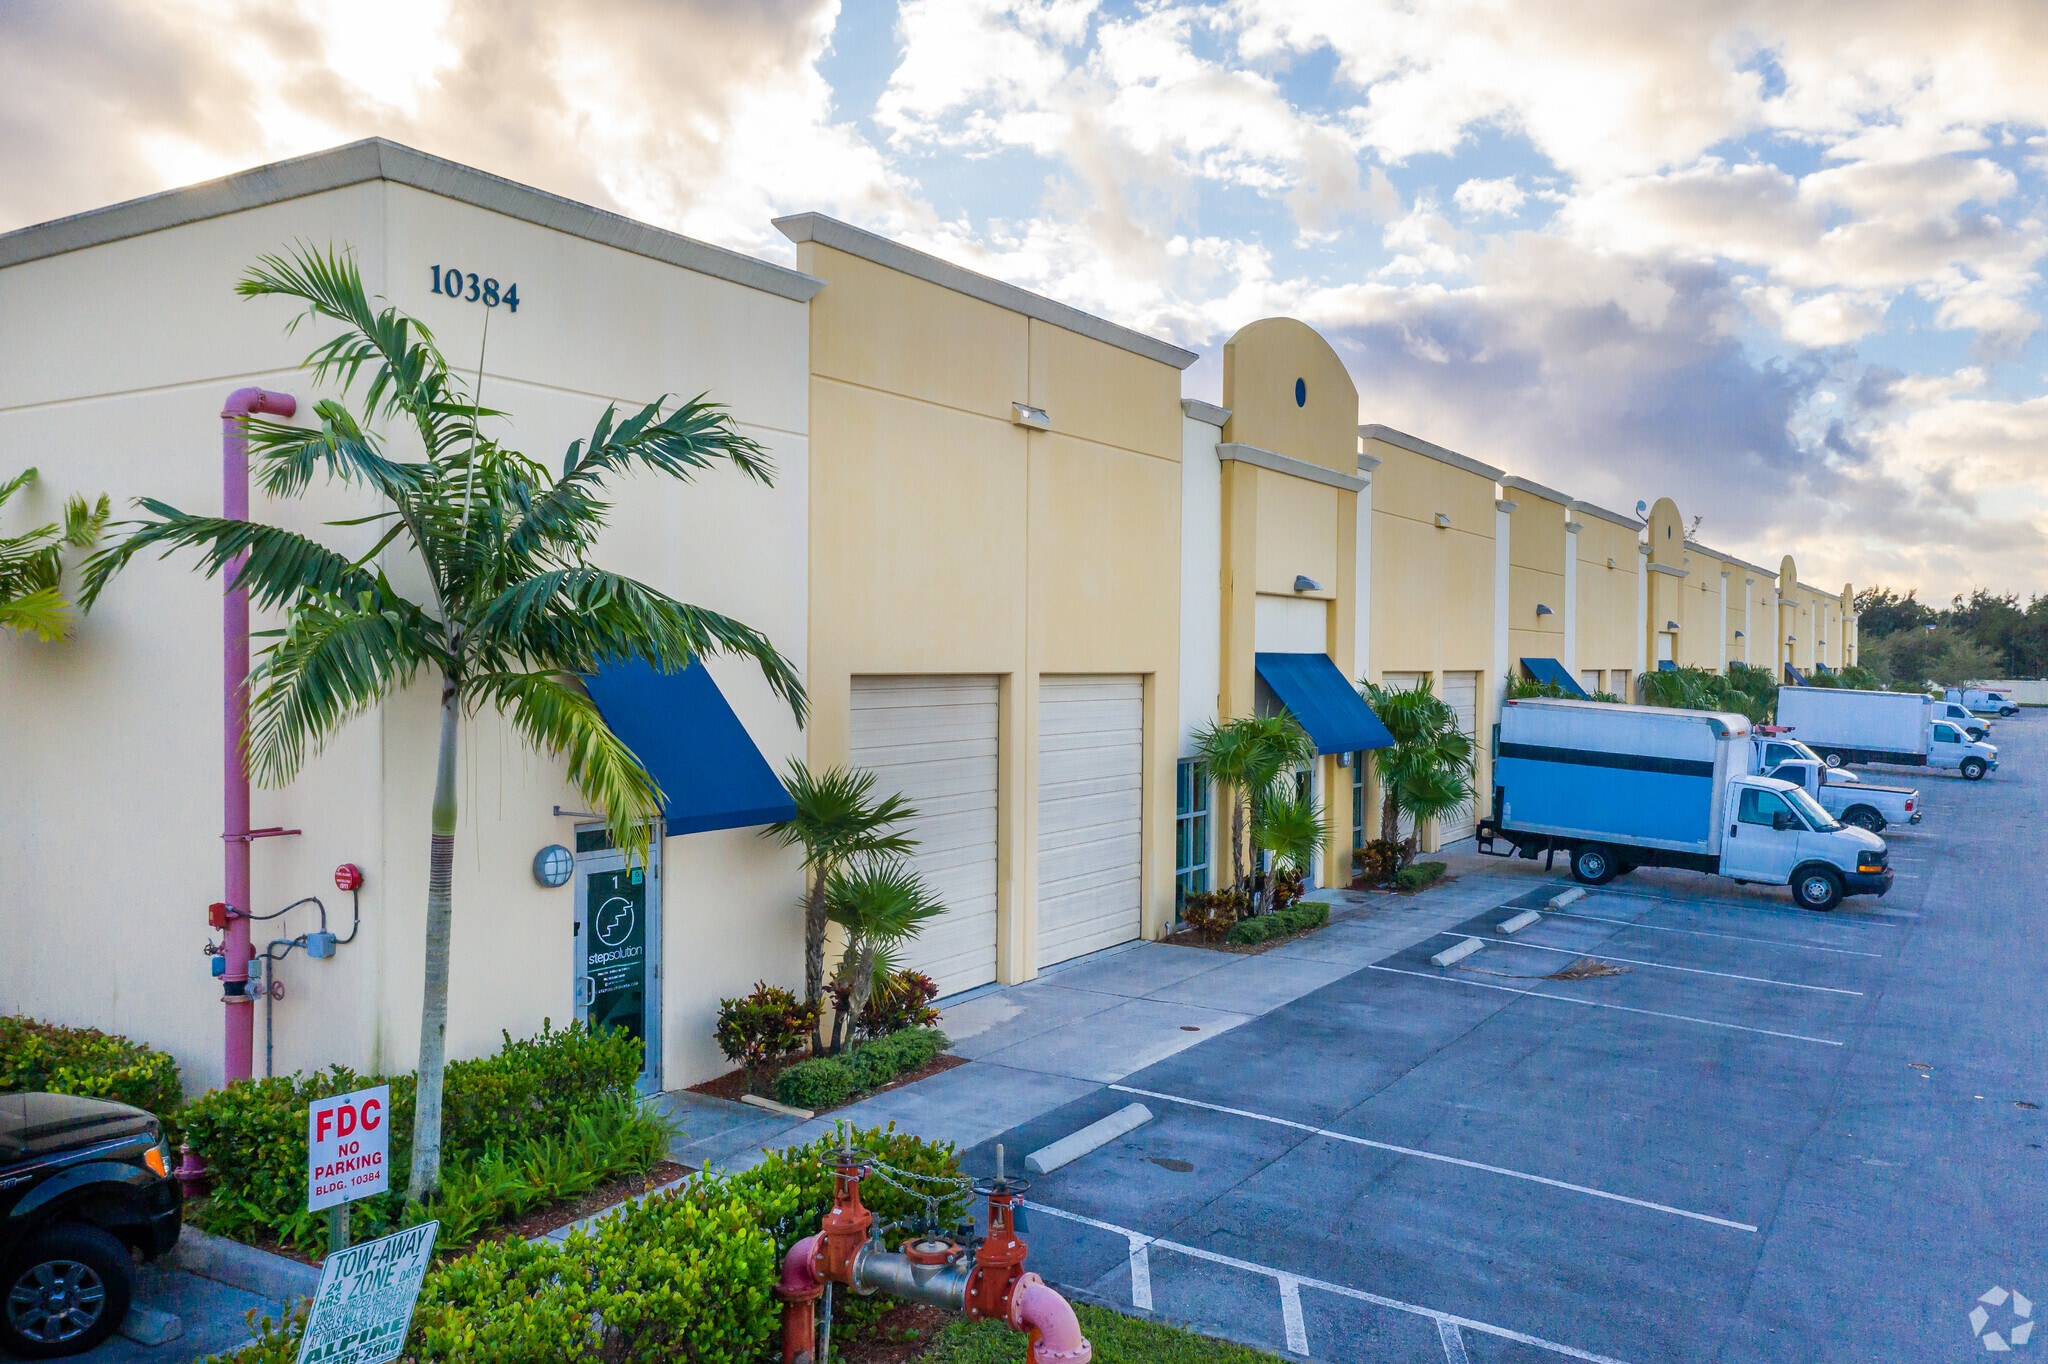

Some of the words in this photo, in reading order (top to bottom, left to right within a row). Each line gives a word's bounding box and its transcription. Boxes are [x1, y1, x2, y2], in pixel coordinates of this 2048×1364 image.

[430, 264, 520, 313] 10384
[612, 875, 618, 889] 1
[588, 945, 643, 965] stepsolution
[316, 1098, 382, 1143] FDC
[338, 1140, 360, 1157] NO
[315, 1151, 382, 1180] PARKING
[316, 1180, 347, 1196] BLDG.
[351, 1170, 380, 1186] 10384
[335, 1227, 428, 1280] TOW-AWAY
[411, 1254, 420, 1267] 7
[348, 1262, 398, 1300] ZONE
[398, 1265, 422, 1283] DAYS
[325, 1280, 343, 1296] 24
[318, 1293, 341, 1311] HRS
[303, 1316, 406, 1364] ALPINE
